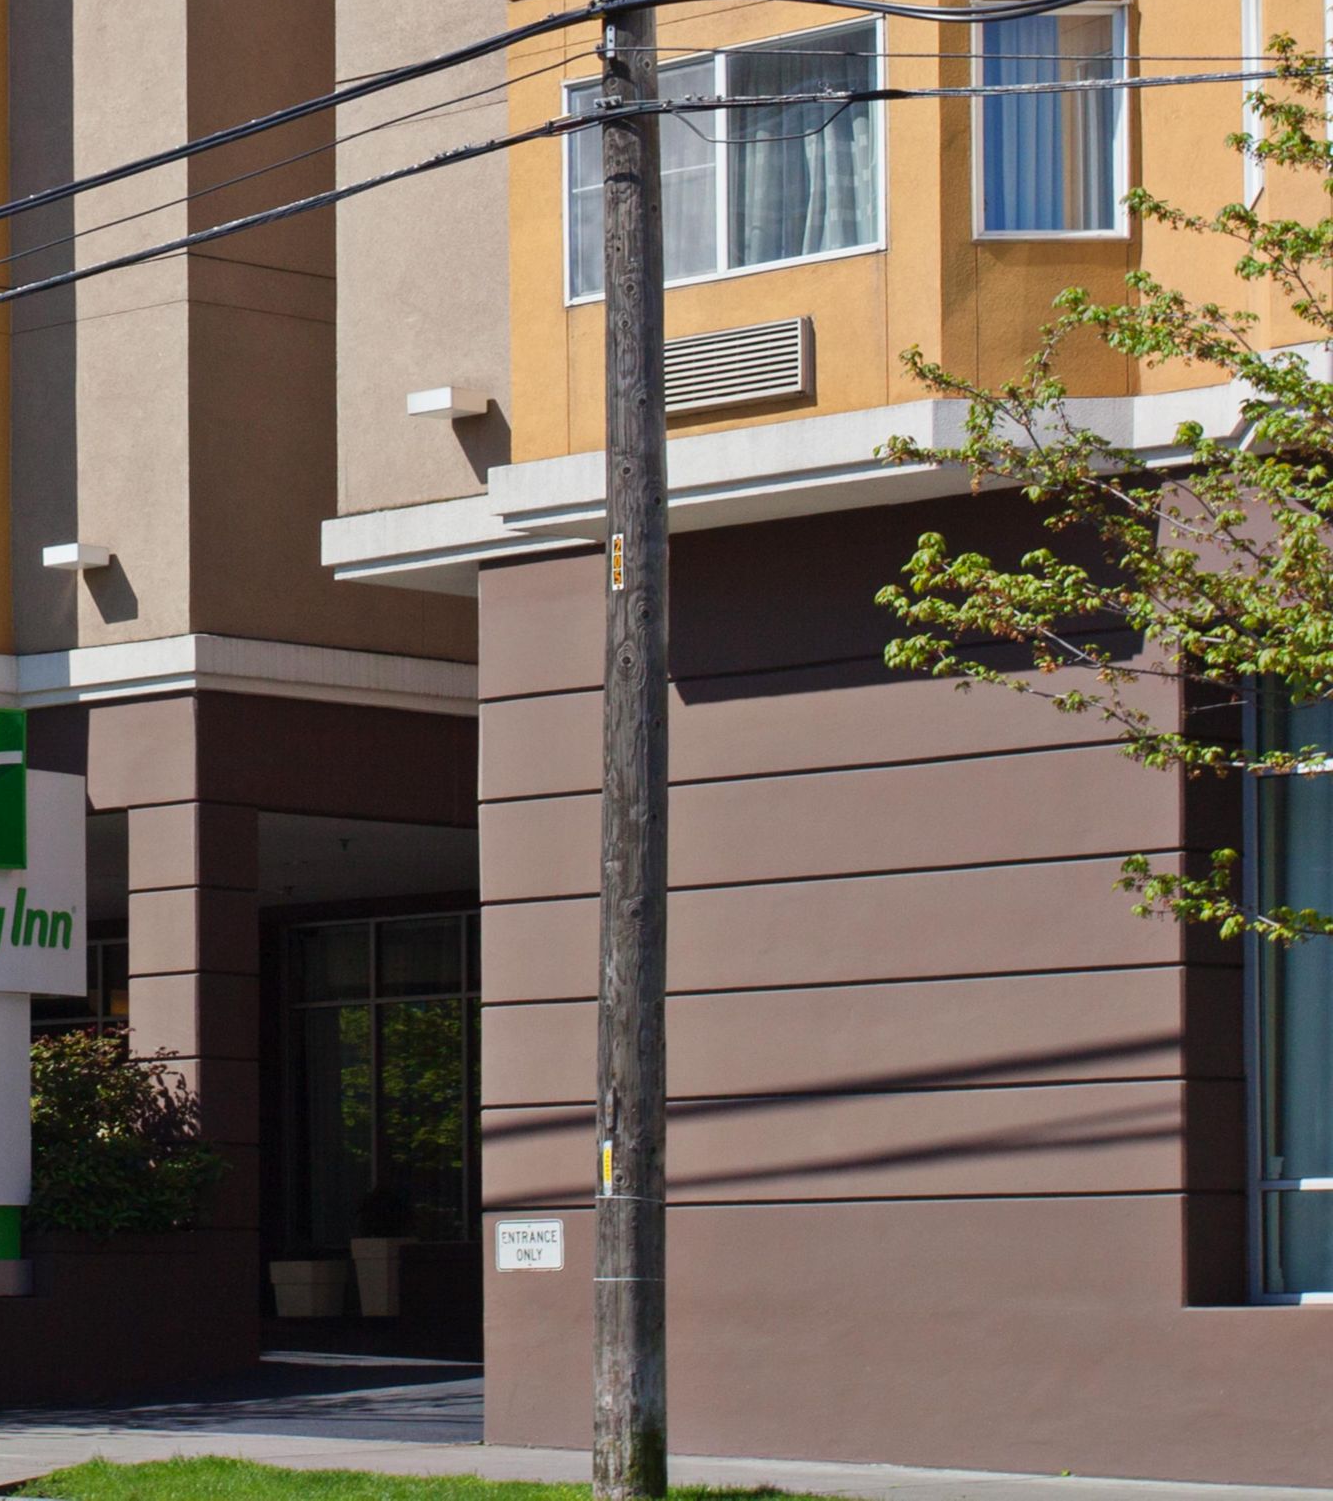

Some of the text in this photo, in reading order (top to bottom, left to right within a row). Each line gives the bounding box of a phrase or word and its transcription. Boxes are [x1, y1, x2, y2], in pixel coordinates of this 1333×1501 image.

[10, 887, 73, 950] Inn
[501, 1230, 557, 1244] ENTRANCE
[516, 1248, 542, 1261] ONLY
